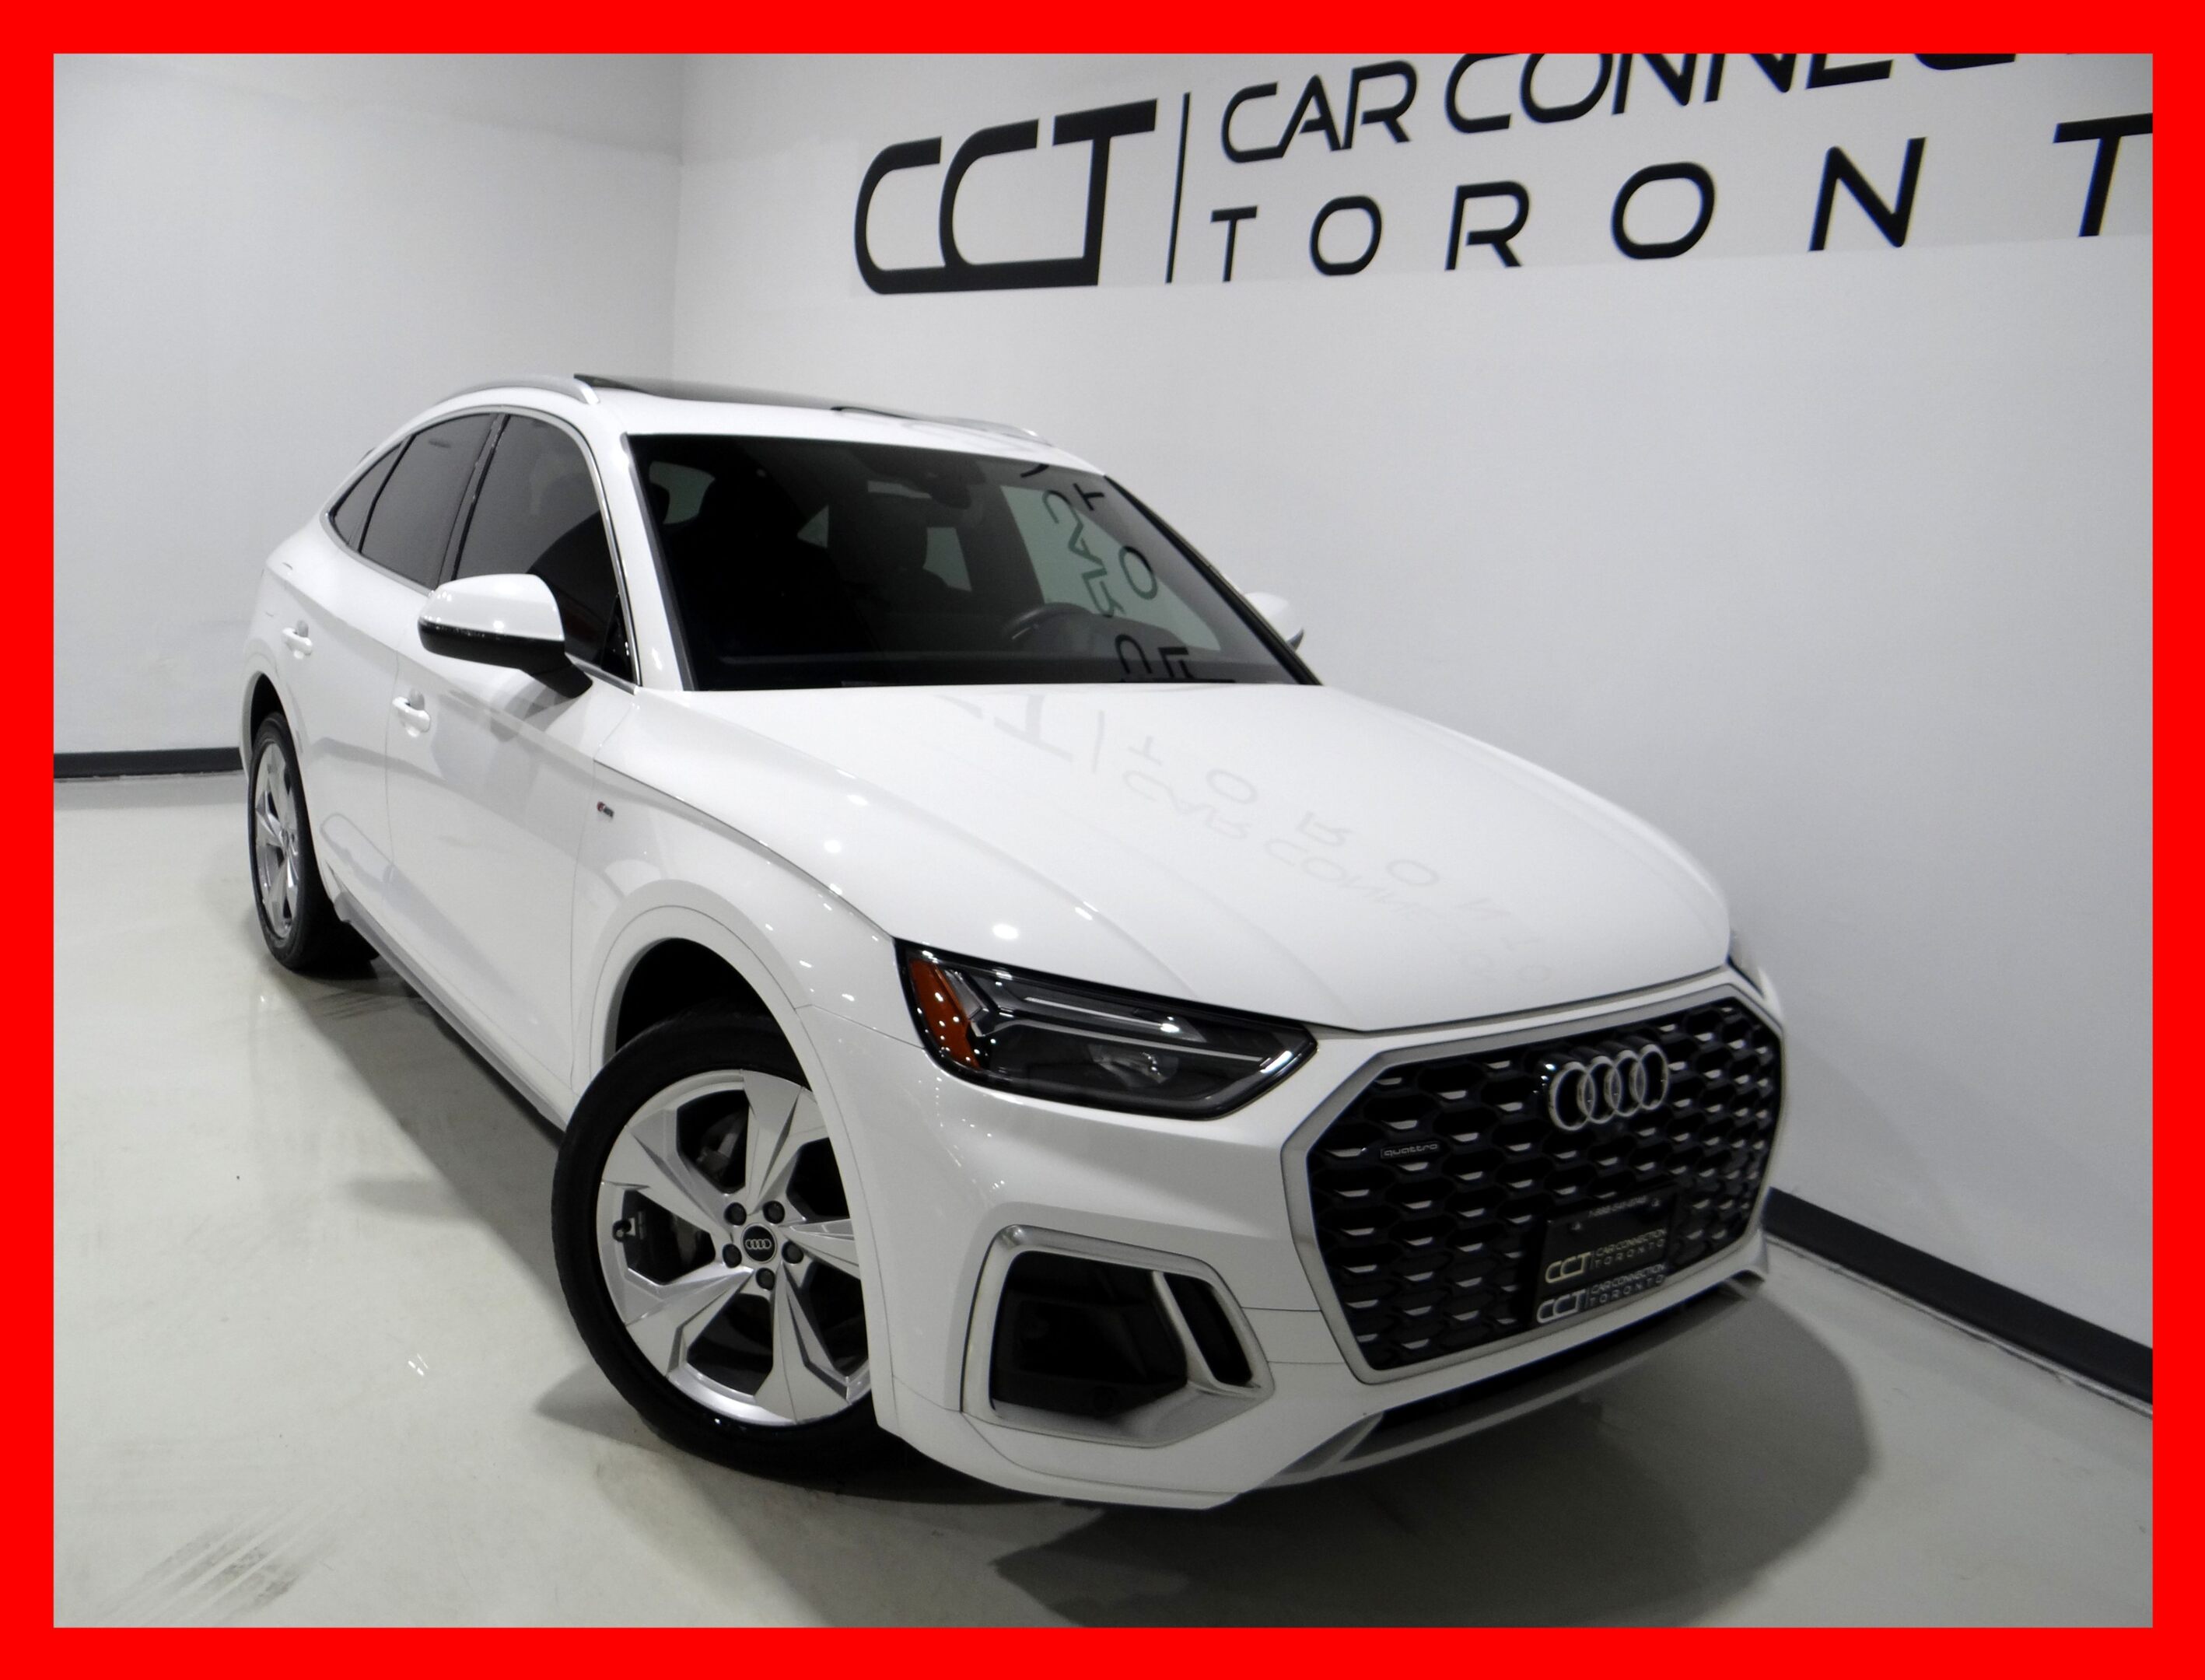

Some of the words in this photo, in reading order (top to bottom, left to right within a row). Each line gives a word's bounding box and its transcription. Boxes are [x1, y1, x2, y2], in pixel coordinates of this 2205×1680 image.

[1221, 59, 1417, 164] CAR
[1444, 54, 2016, 134] CONN
[854, 98, 1158, 295] CCT
[1384, 1143, 1438, 1157] quattro
[1594, 1238, 1665, 1269] TORONTO
[1595, 1244, 1615, 1257] CAR
[1545, 1251, 1591, 1284] CCT
[1589, 1274, 1665, 1307] TORONTO
[1591, 1280, 1612, 1294] CAR
[1536, 1288, 1587, 1324] CCT
